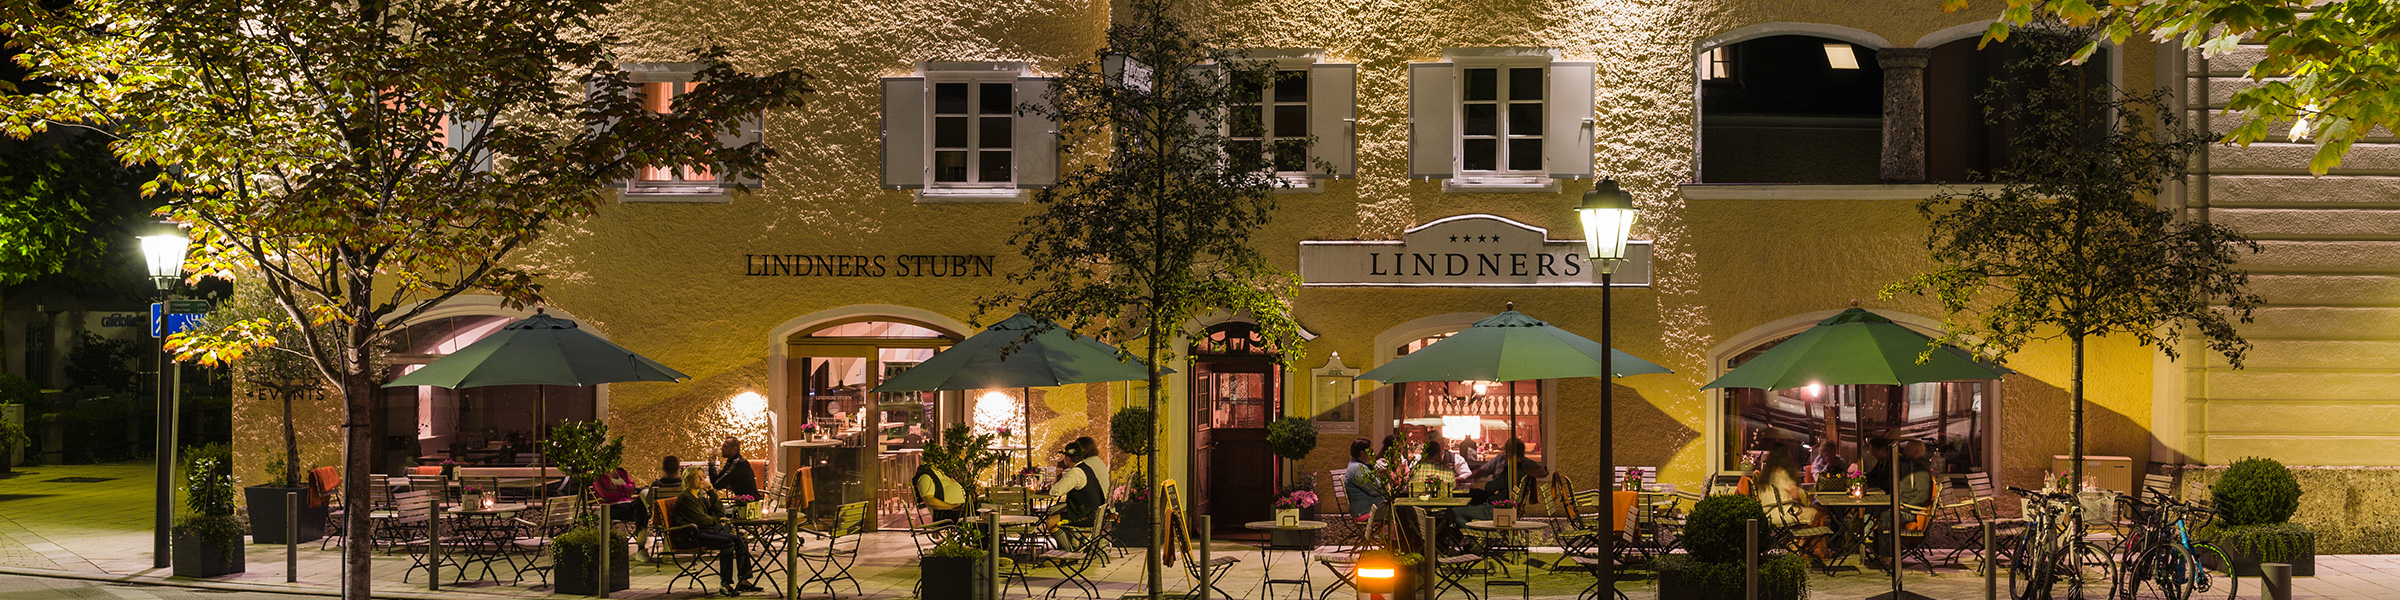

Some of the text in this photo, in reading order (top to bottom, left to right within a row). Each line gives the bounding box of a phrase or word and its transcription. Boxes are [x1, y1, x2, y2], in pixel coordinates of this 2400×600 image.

[745, 254, 996, 277] LINDNERS STUB'N
[1369, 252, 1582, 277] LINDNERS
[258, 388, 325, 401] EVNTS
